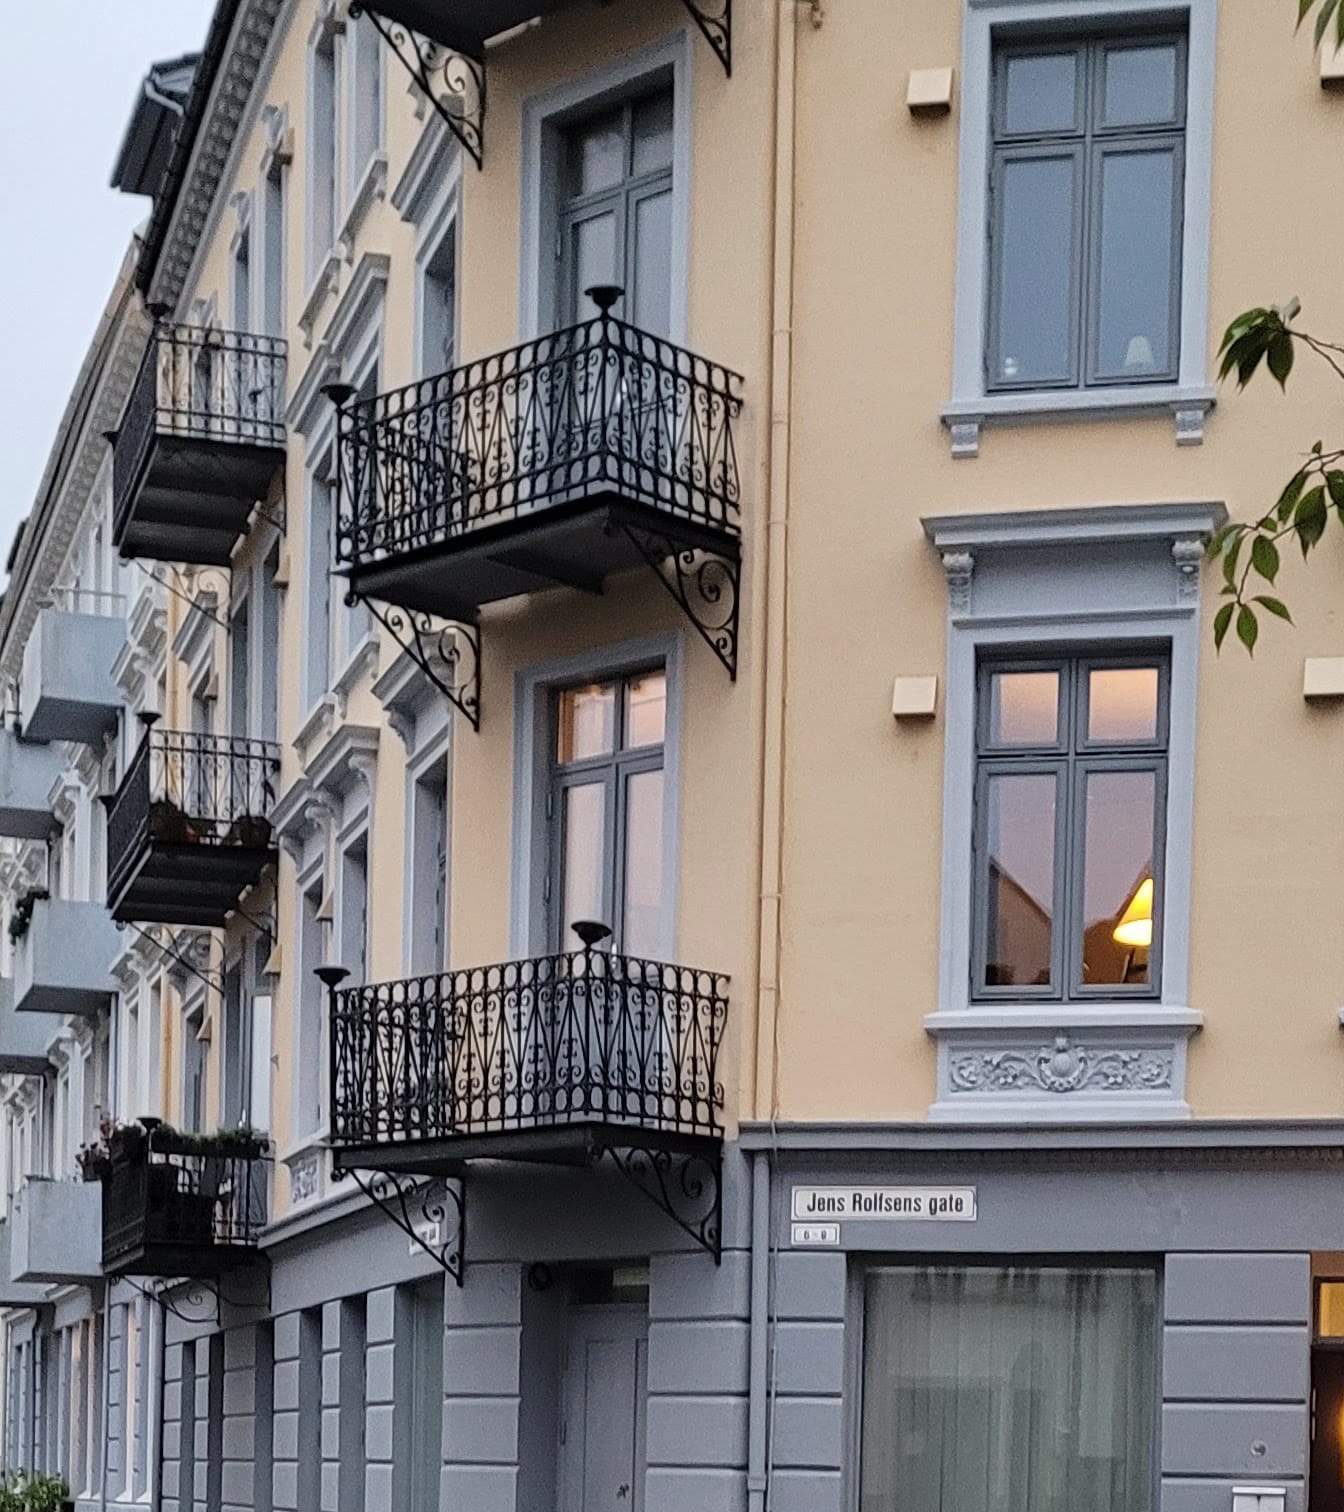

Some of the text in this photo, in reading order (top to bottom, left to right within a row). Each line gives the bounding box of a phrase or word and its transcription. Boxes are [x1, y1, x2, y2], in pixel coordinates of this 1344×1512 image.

[807, 1192, 963, 1216] Jens Rolfsens gate
